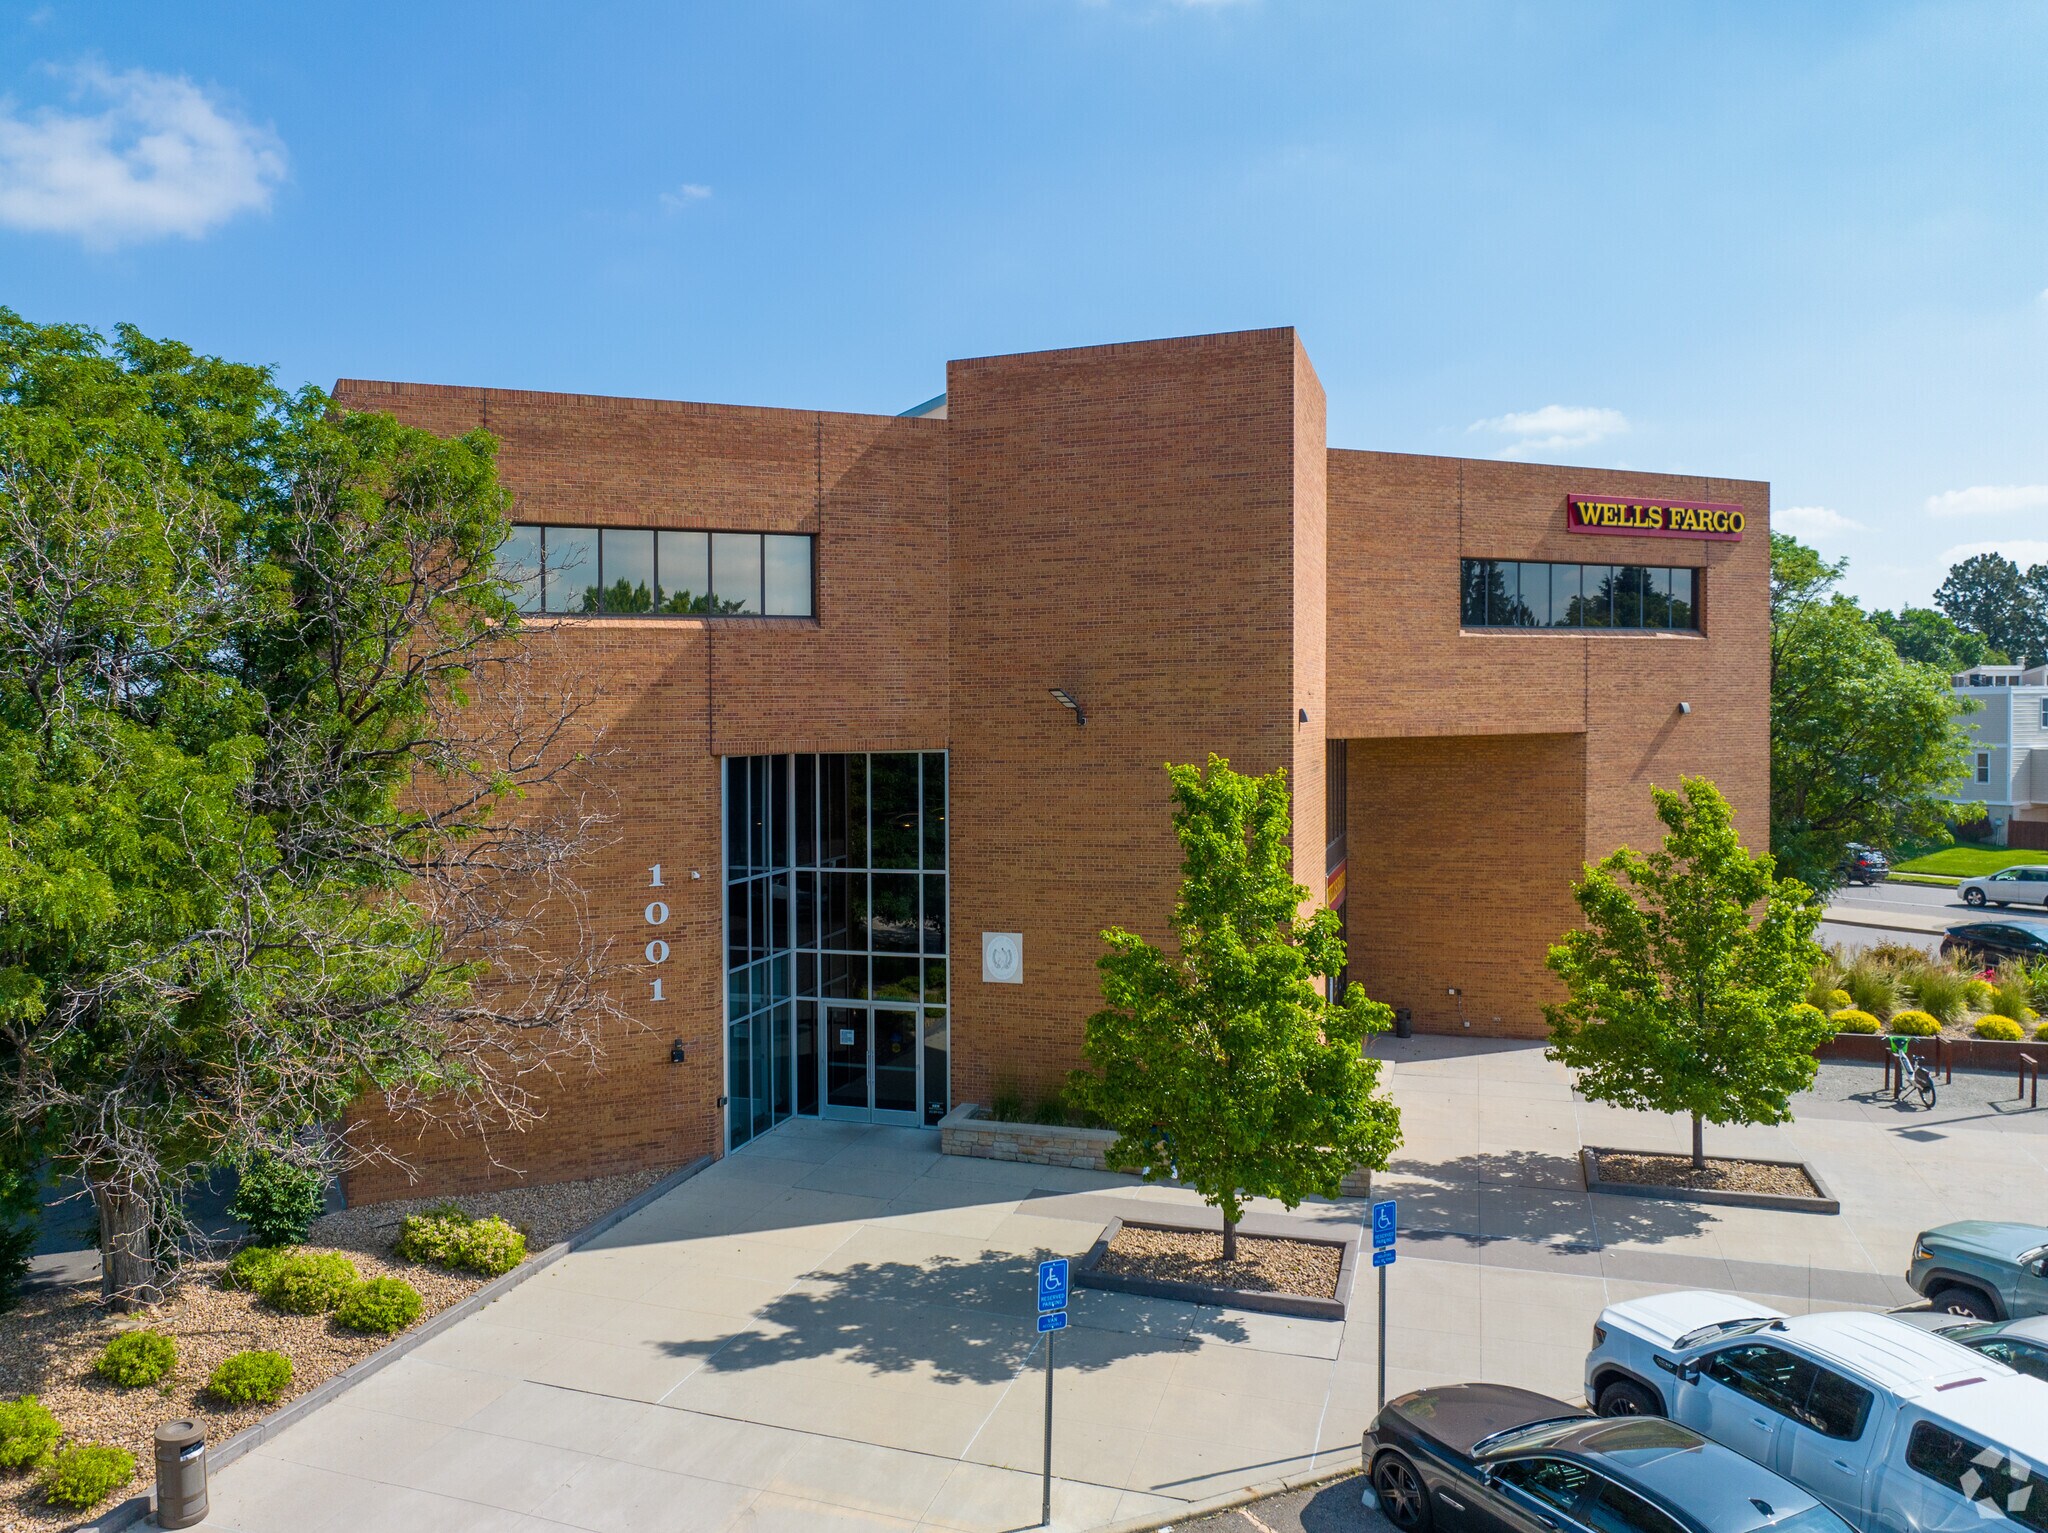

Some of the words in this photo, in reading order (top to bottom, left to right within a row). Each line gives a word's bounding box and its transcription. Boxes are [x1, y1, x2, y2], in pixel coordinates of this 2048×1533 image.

[1577, 502, 1663, 529] WELLS
[1669, 507, 1745, 533] FARGO
[644, 863, 670, 1002] 1001
